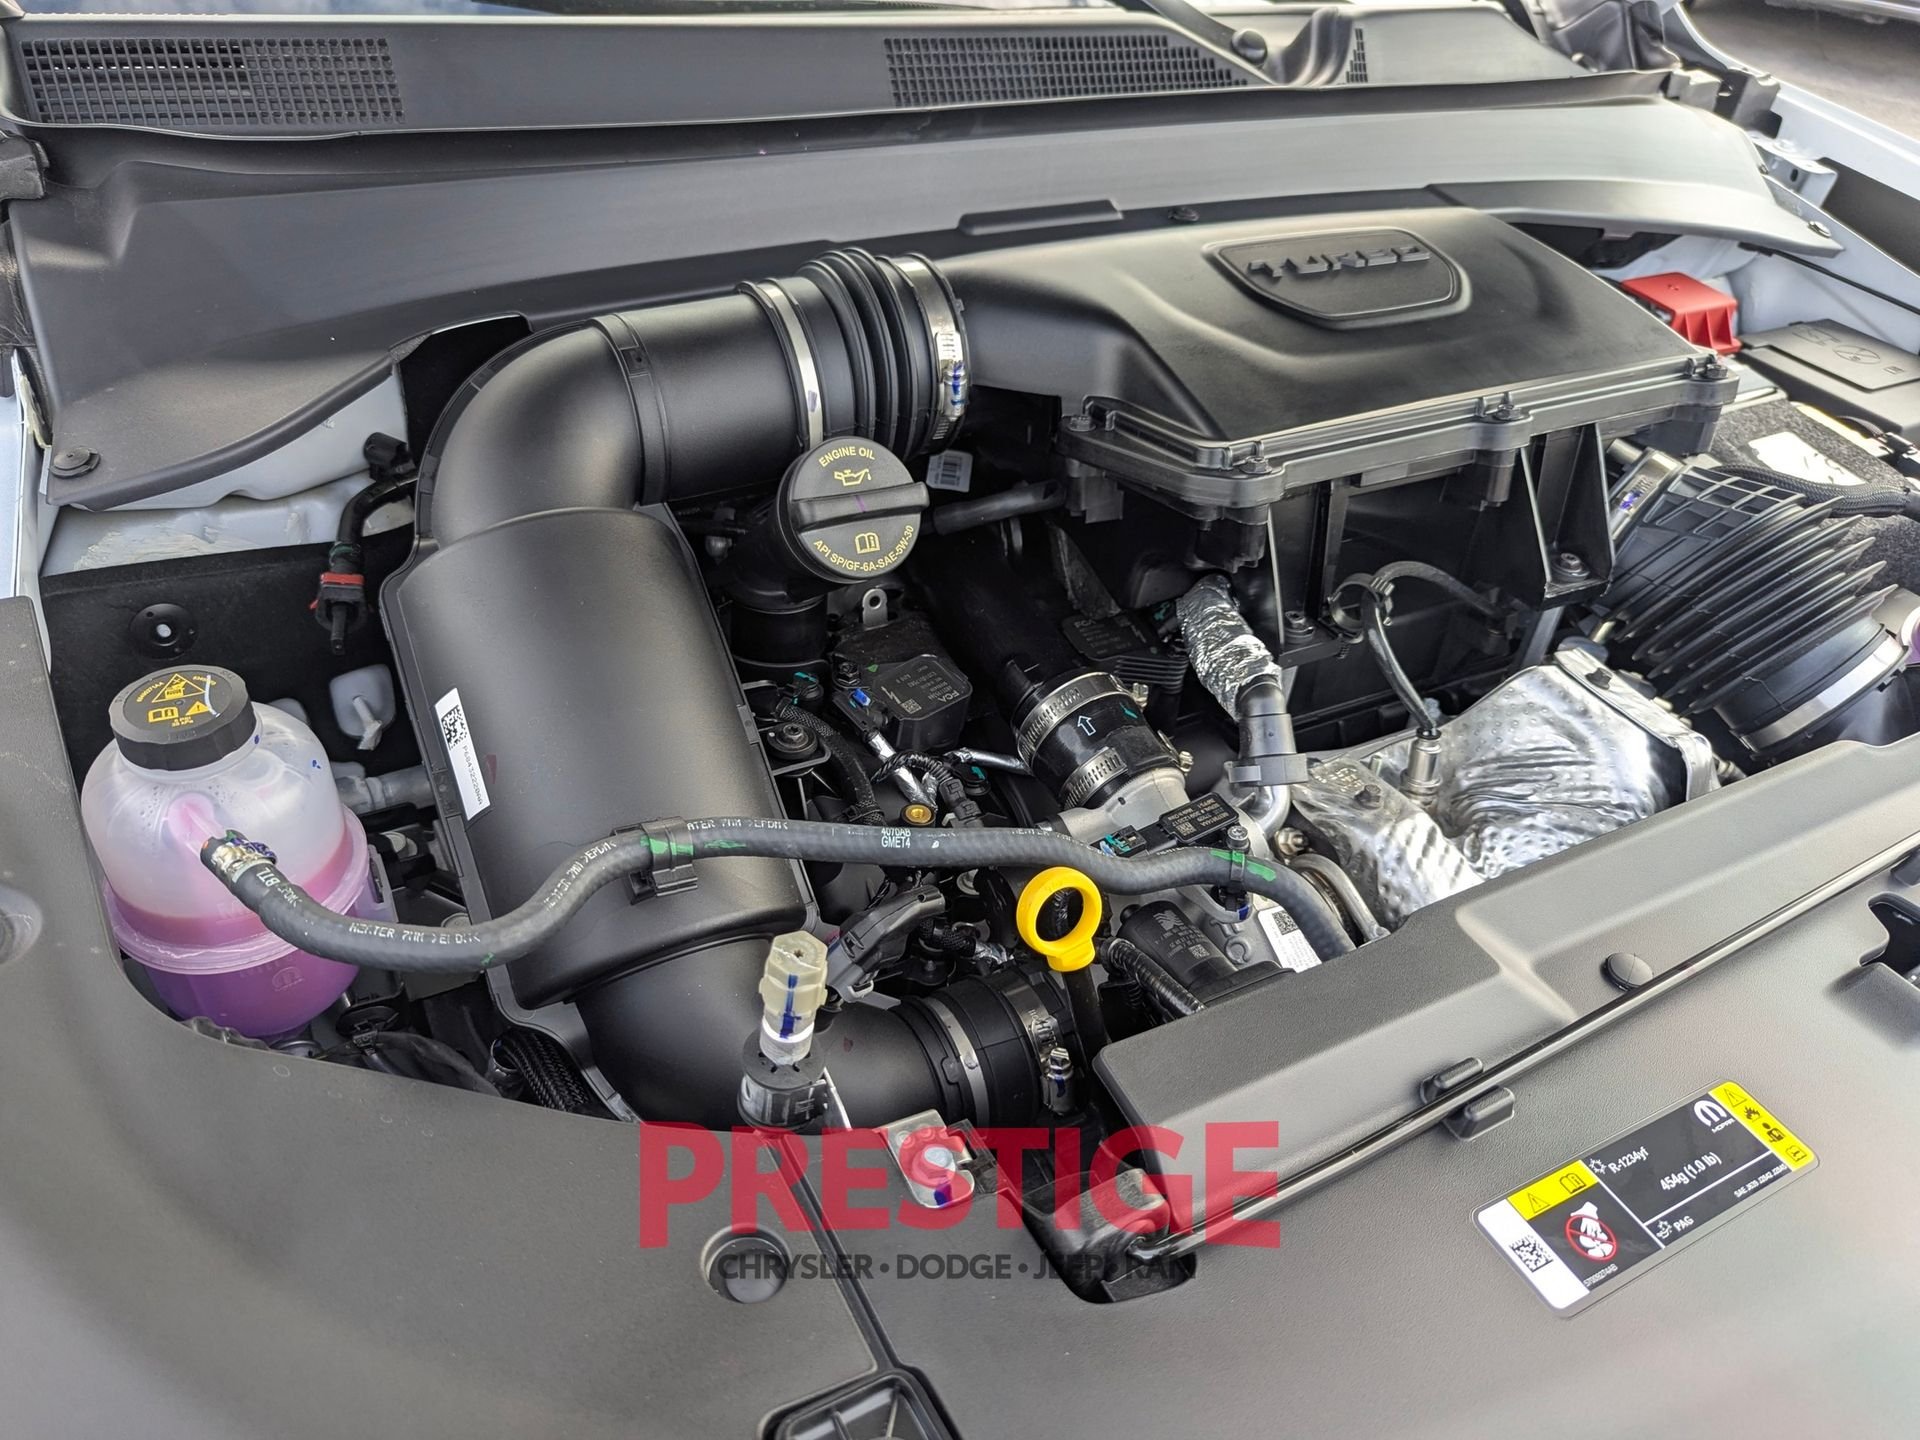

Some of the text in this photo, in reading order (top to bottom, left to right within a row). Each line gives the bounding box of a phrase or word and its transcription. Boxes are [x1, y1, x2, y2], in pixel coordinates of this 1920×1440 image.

[1249, 246, 1431, 279] TURBO
[818, 446, 876, 468] ENGINE OIL
[813, 539, 831, 558] API
[881, 836, 912, 849] GMET4
[1607, 1146, 1650, 1174] R-1234yf
[1660, 1151, 1722, 1192] 454g (1.0 lb)
[1673, 1214, 1694, 1233] PAG
